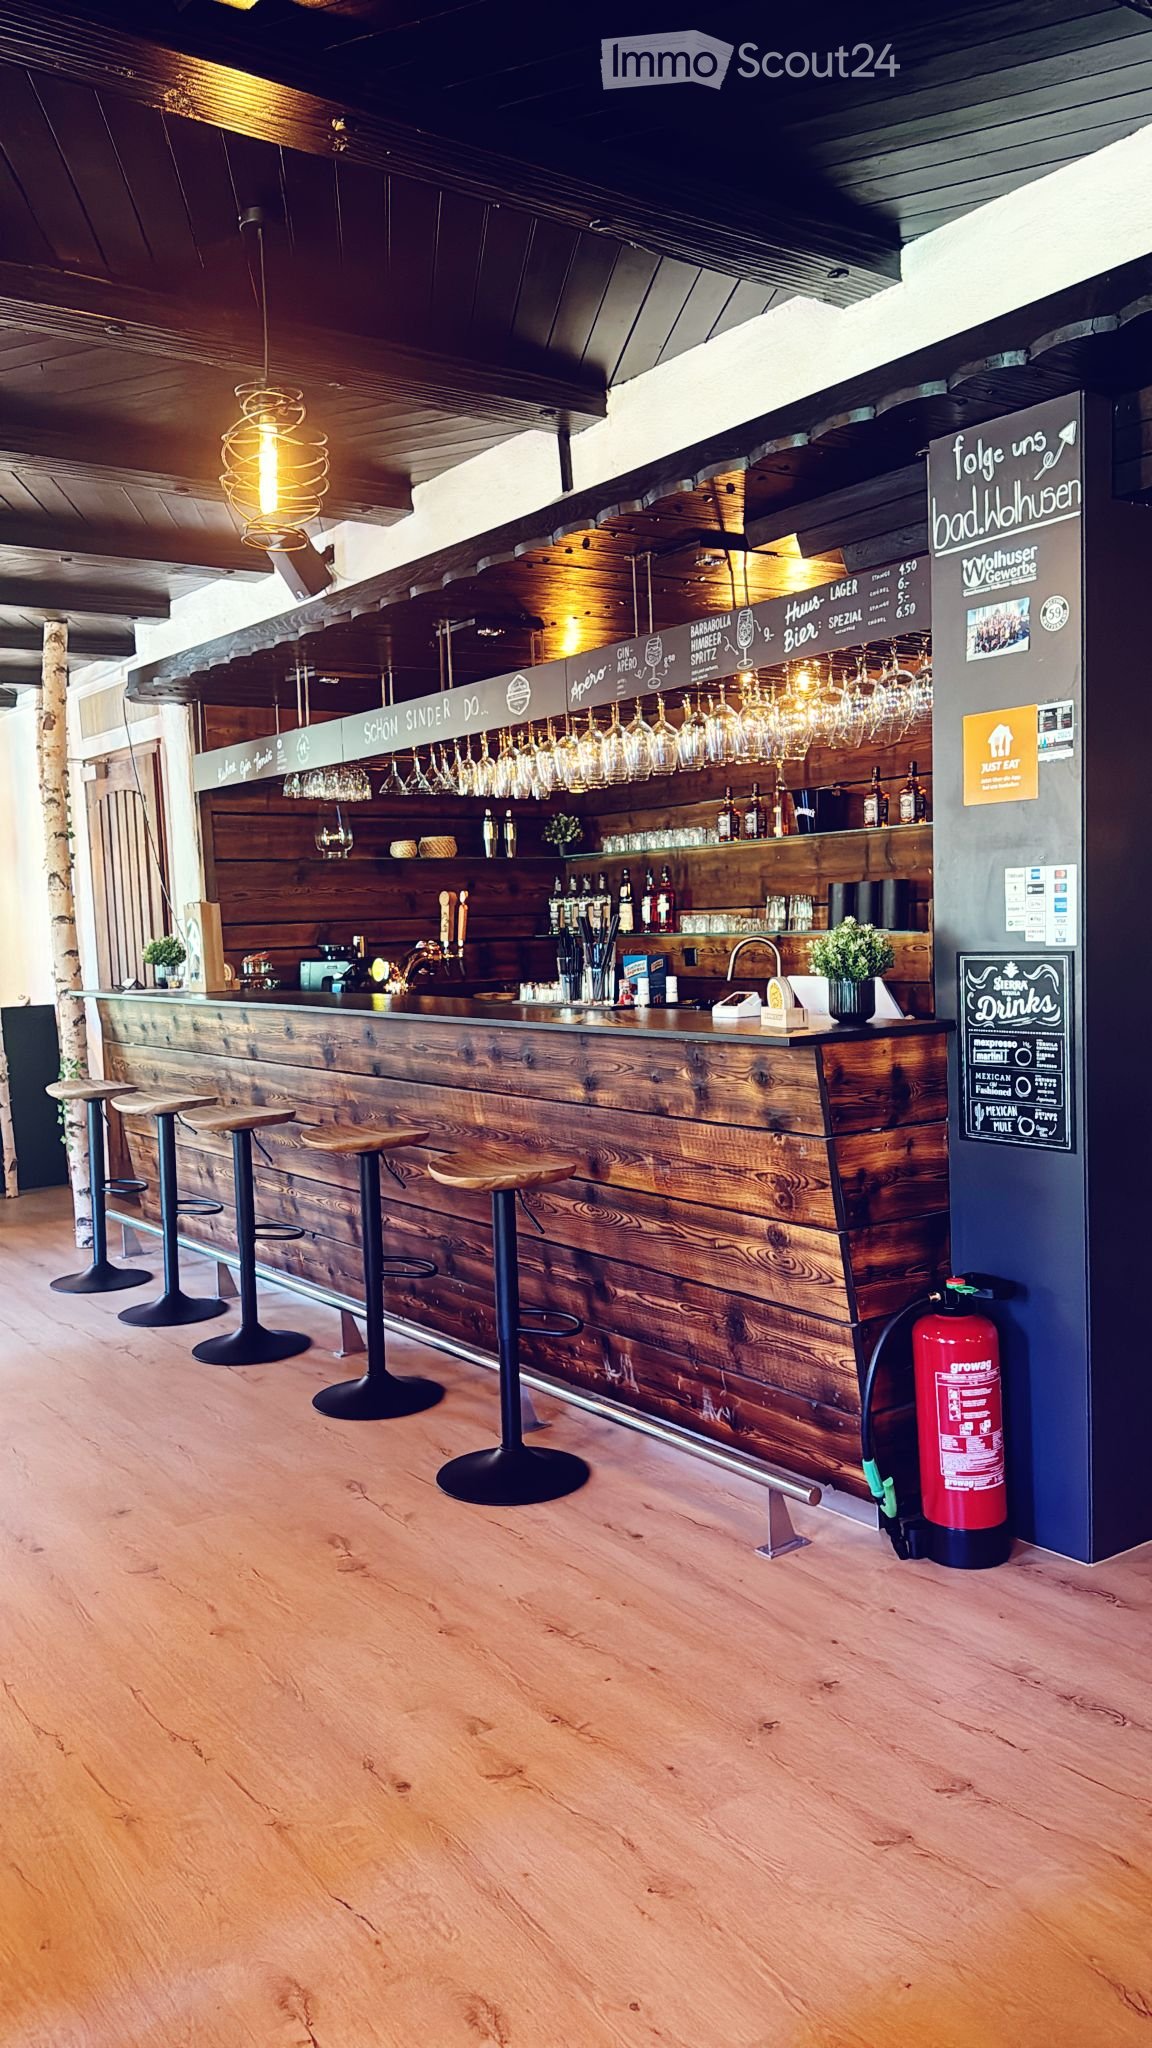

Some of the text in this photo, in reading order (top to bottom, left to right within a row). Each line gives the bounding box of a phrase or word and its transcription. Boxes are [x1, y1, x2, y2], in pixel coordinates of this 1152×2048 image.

[953, 431, 1047, 482] folge uns
[932, 478, 1081, 549] bad.Wolhusen
[899, 559, 918, 576] 4.50
[962, 545, 1038, 588] Wolhuser
[985, 561, 1037, 583] Gewerbe
[829, 578, 858, 601] LAGER
[895, 602, 916, 619] 6.50
[1047, 606, 1062, 621] 59
[690, 614, 732, 639] BARBABOLLA
[828, 609, 863, 630] SPEZIAL
[690, 631, 722, 653] HIMBEER
[616, 645, 634, 660] GIN-
[690, 647, 717, 666] SPRITZ
[616, 656, 638, 673] APÉRO
[363, 715, 398, 745] SCHÖN
[405, 697, 451, 731] SINDER
[981, 759, 1021, 774] JUST EAT
[993, 976, 1028, 991] SIERRA
[975, 988, 1057, 1020] Drinks
[974, 1038, 1018, 1049] mexpresso
[976, 1051, 1003, 1061] martini
[975, 1072, 1011, 1082] MEXICAN
[975, 1085, 1012, 1097] Fashioned
[985, 1105, 1018, 1117] MEXICAN
[993, 1121, 1013, 1133] MULE
[950, 1360, 992, 1373] growag
